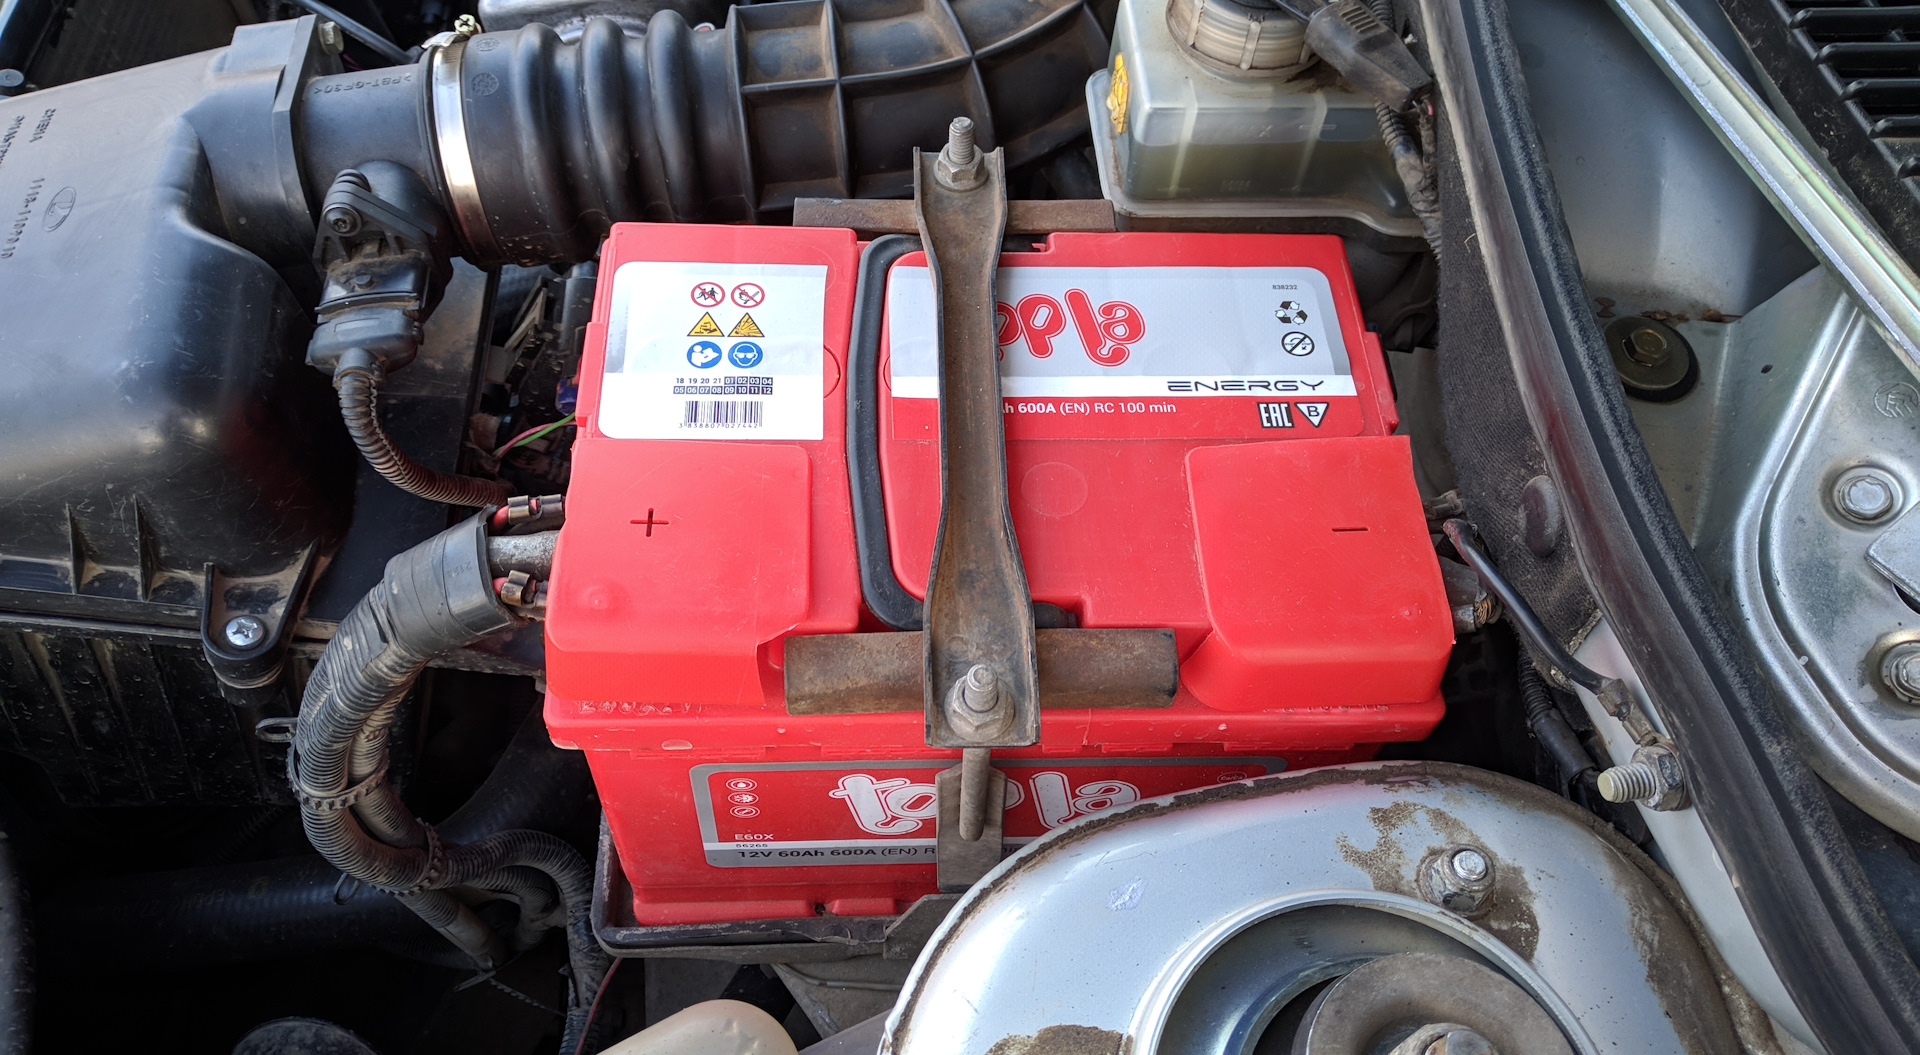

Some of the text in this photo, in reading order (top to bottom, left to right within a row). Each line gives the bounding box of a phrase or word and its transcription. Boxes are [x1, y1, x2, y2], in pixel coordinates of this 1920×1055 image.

[749, 377, 760, 385] 03
[762, 377, 772, 385] 04
[1167, 380, 1324, 392] ENERGY
[1018, 402, 1057, 414] 600A
[1060, 402, 1090, 416] (EN)
[1094, 402, 1115, 414] RC
[1119, 402, 1145, 414] 100
[1150, 401, 1176, 413] min
[1306, 405, 1320, 418] B
[734, 833, 774, 841] E60X
[738, 850, 772, 858] 12V
[778, 850, 824, 858] 60Ah
[830, 848, 877, 857] 600A
[881, 847, 918, 857] (EN)
